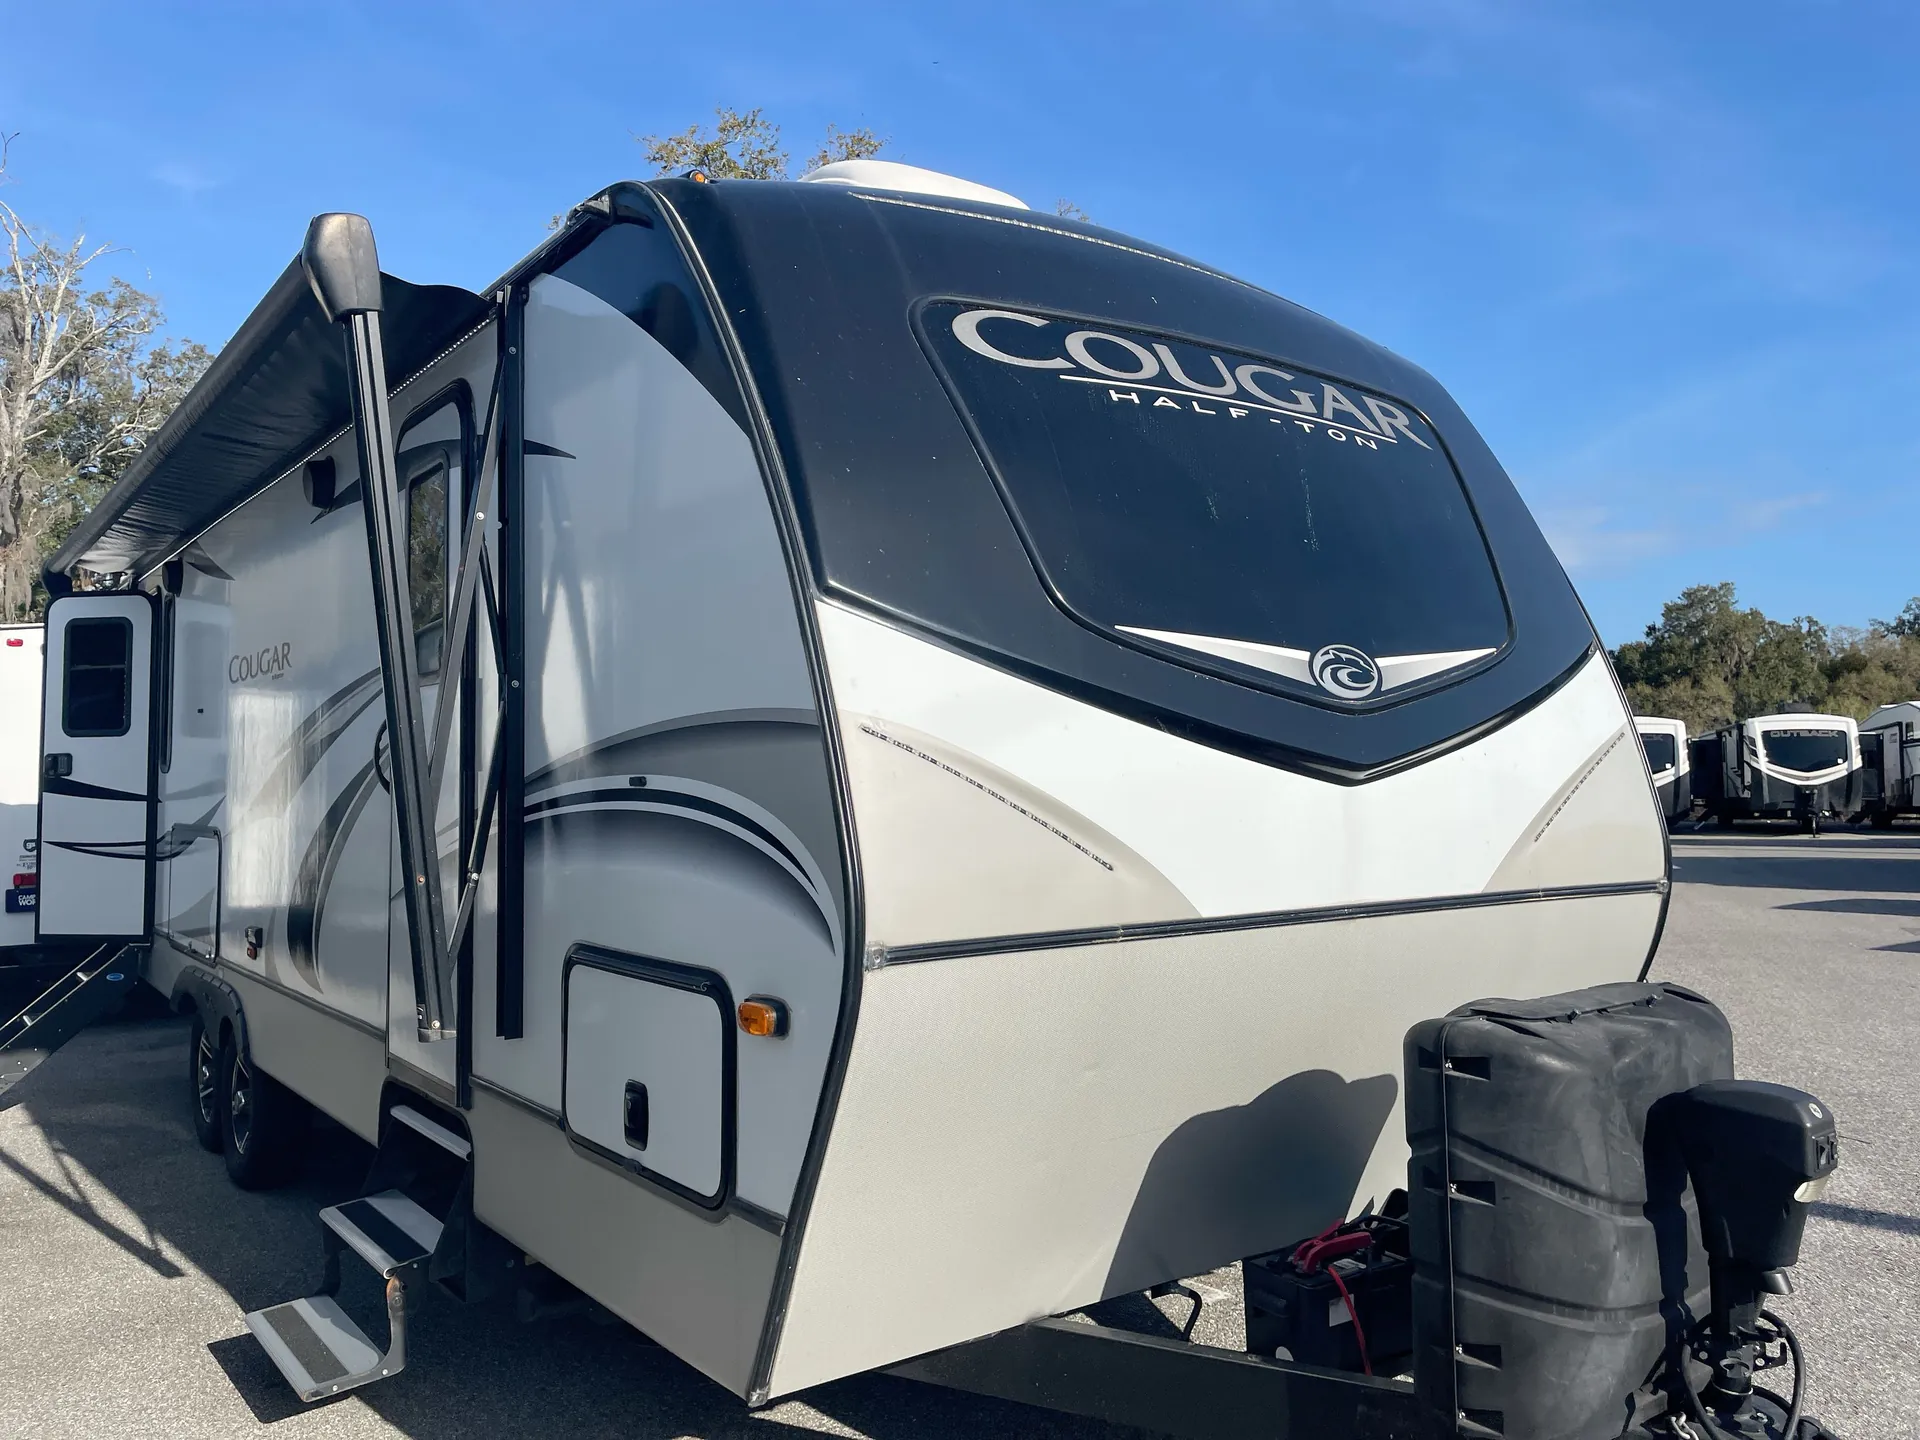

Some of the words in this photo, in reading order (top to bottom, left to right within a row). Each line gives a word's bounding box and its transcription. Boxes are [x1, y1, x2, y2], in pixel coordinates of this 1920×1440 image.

[951, 309, 1434, 450] COUGAR
[1108, 389, 1378, 450] HALF-TON
[228, 642, 292, 684] COUGAR
[1770, 730, 1839, 738] OUTBACK
